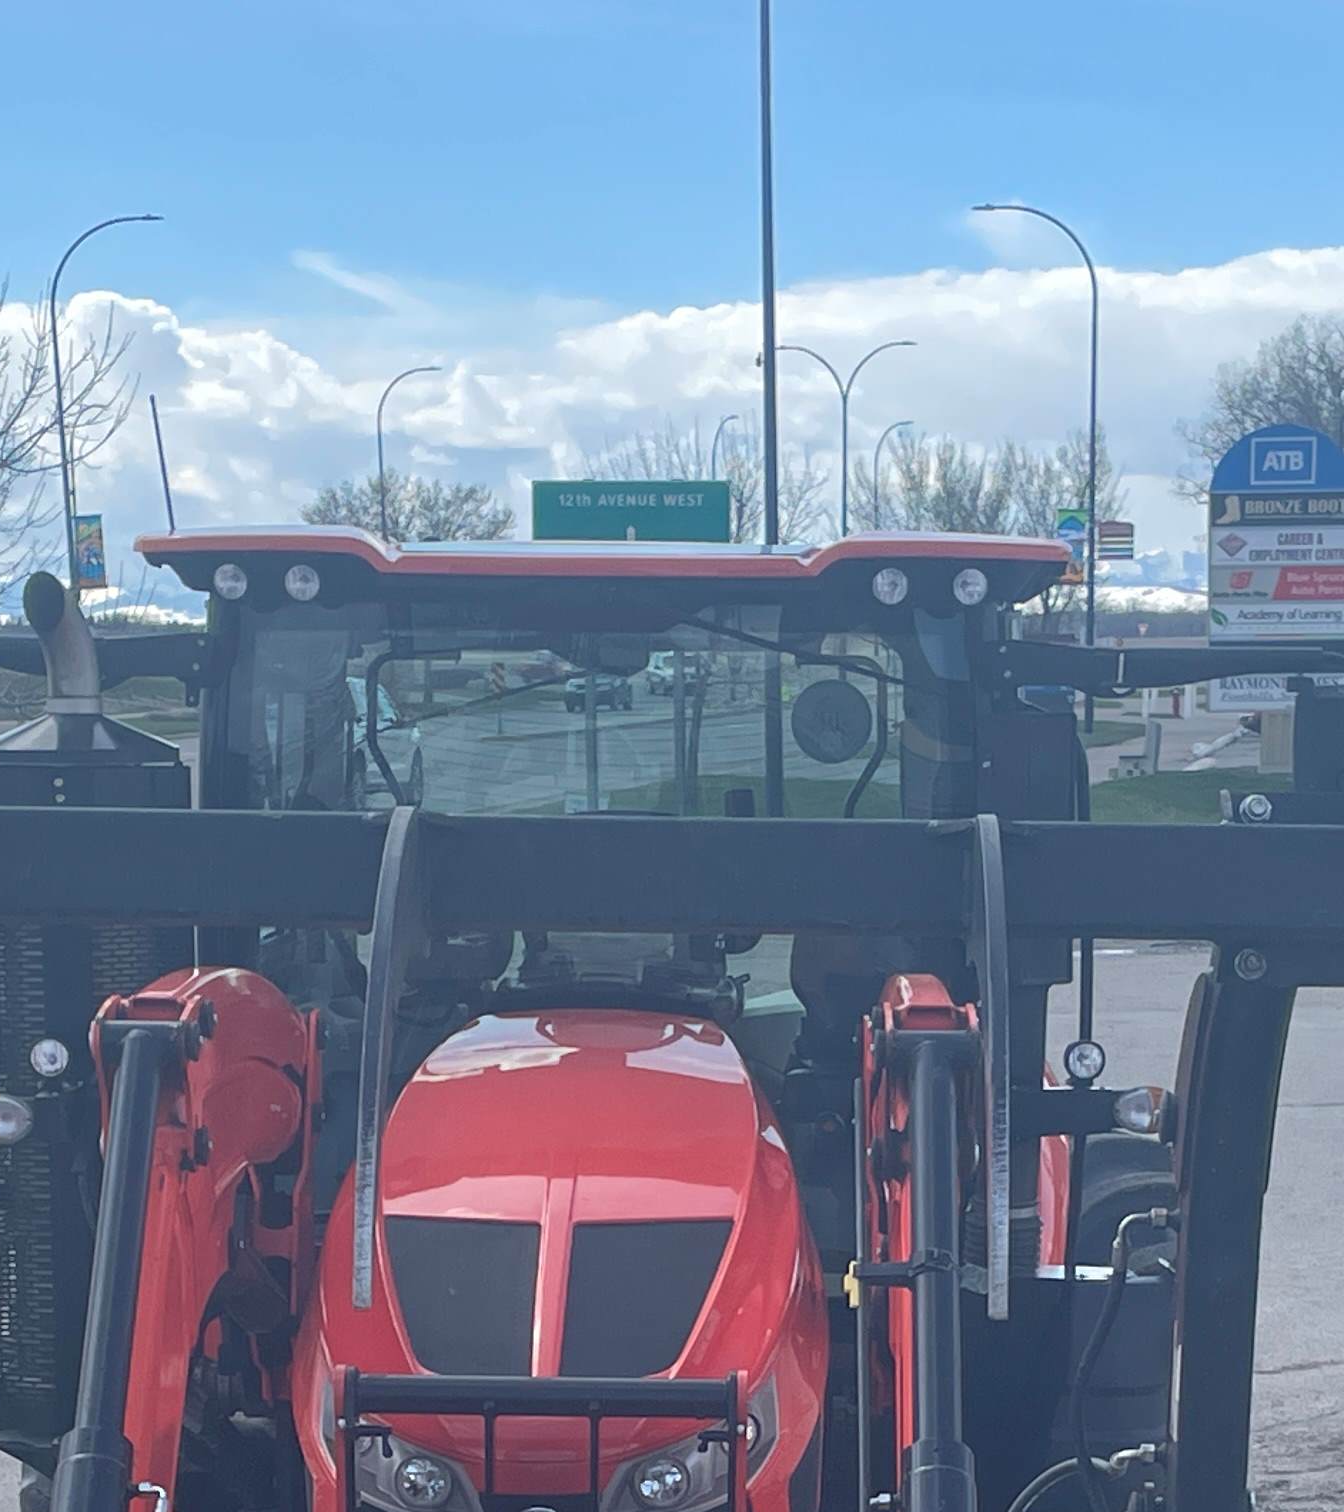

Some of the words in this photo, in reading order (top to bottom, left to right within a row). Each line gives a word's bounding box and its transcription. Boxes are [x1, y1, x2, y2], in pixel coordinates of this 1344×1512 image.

[1262, 450, 1304, 471] ATB
[559, 494, 591, 507] 12th
[597, 494, 657, 507] AVENUE
[664, 494, 705, 506] WEST
[1245, 500, 1304, 514] BRONZE
[1277, 533, 1314, 546] CAREER
[1248, 549, 1313, 561] EMPLOYMENT
[1237, 609, 1283, 621] Academy
[1287, 608, 1298, 619] of
[1299, 609, 1343, 621] Learning
